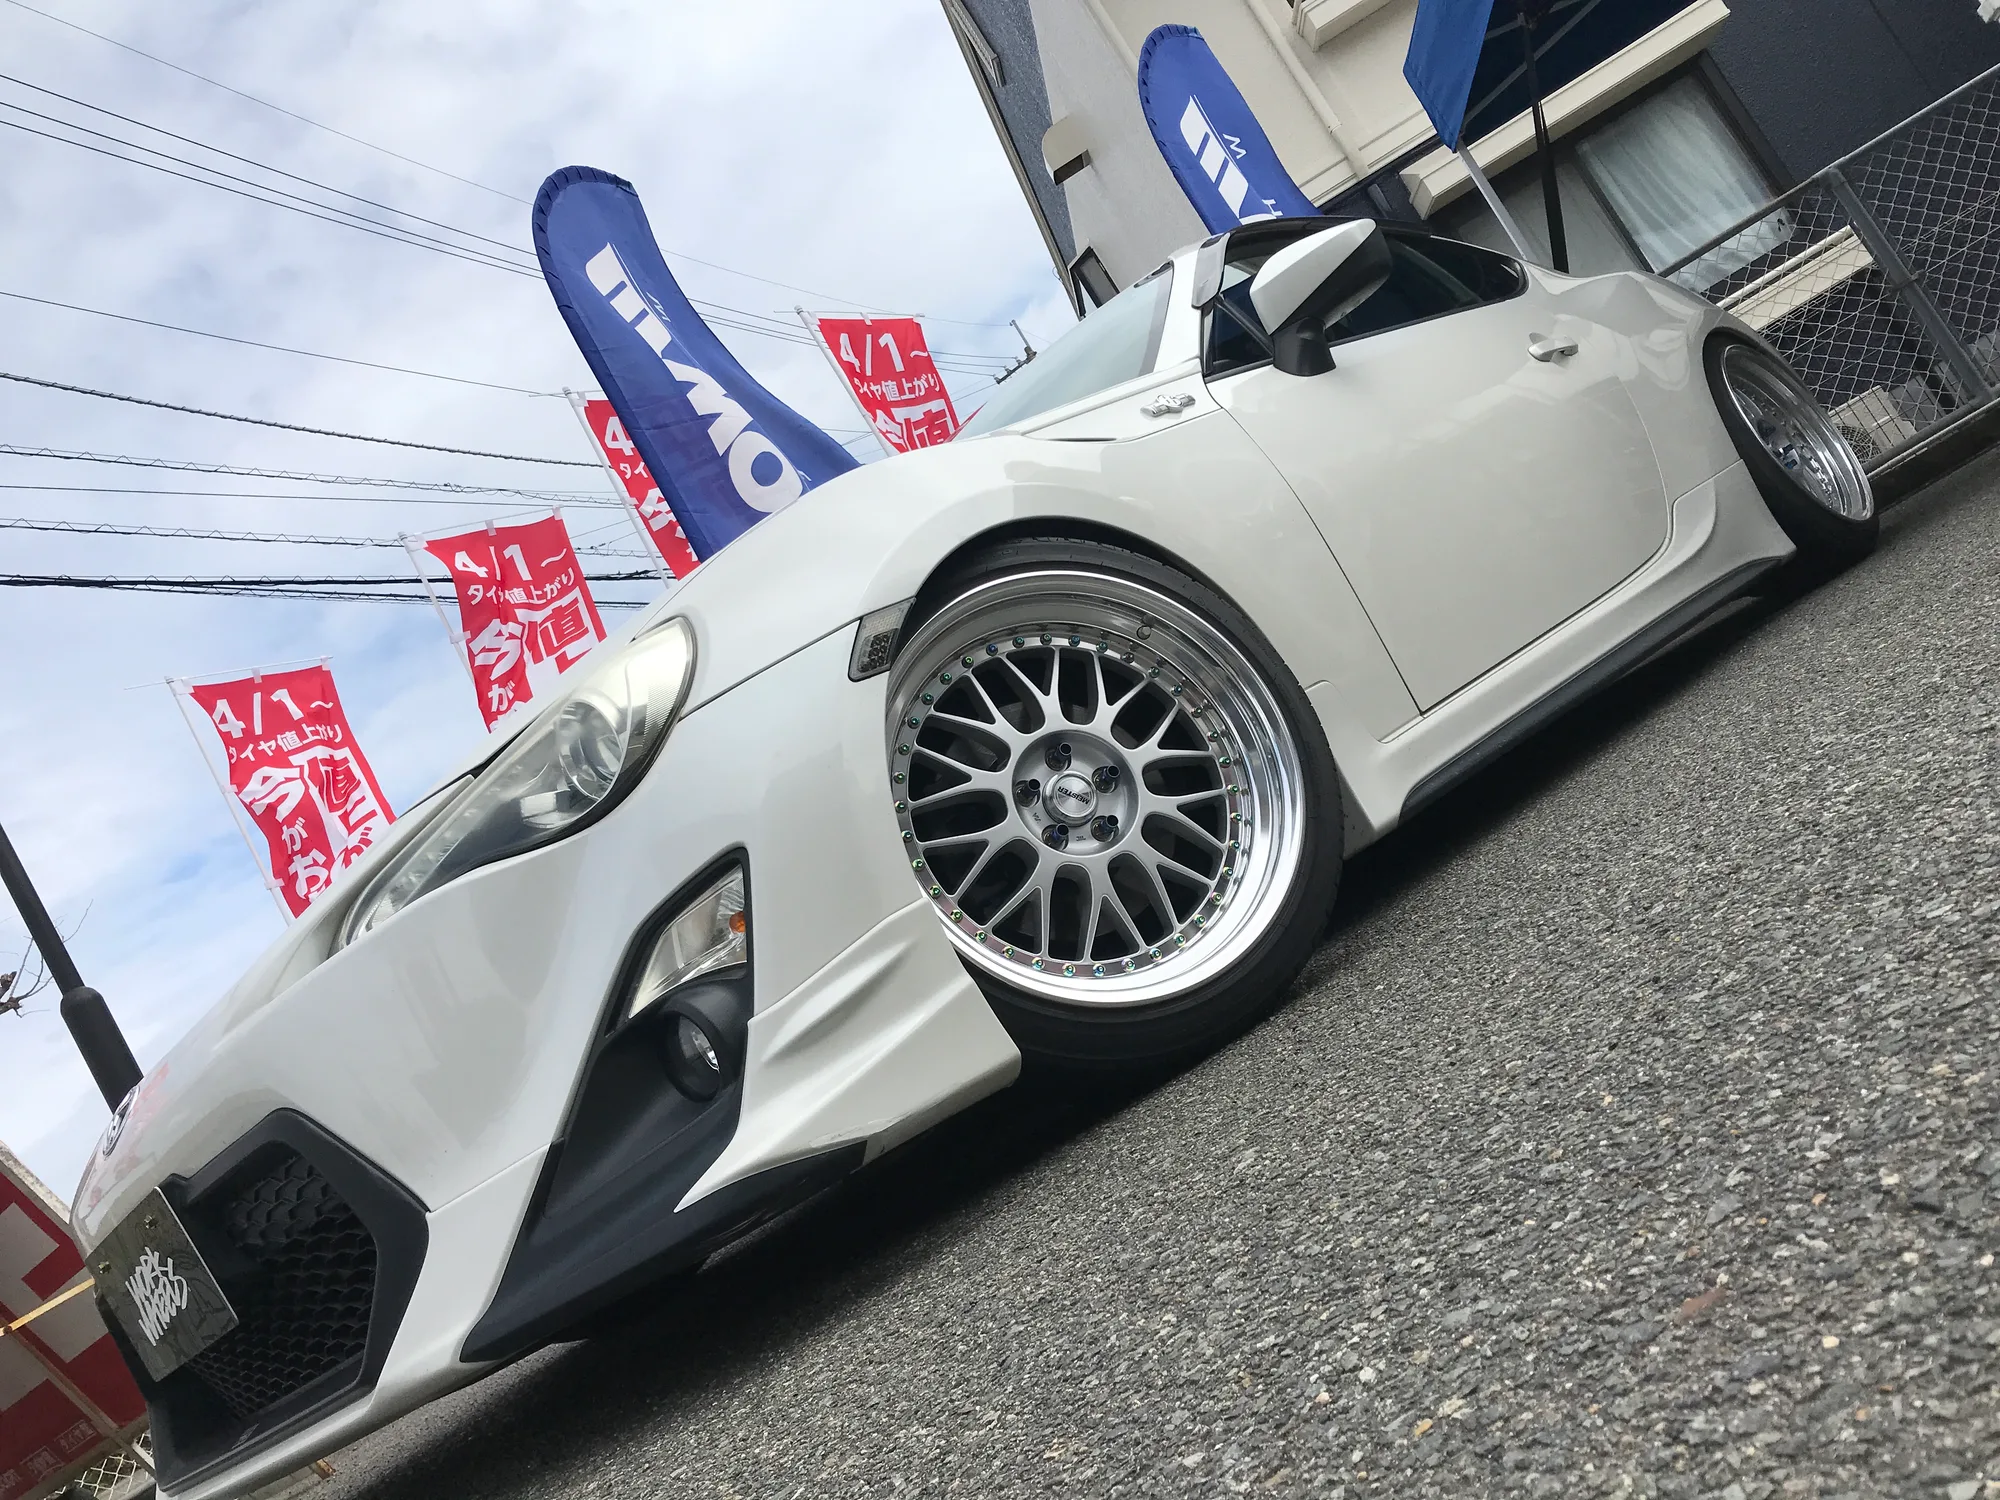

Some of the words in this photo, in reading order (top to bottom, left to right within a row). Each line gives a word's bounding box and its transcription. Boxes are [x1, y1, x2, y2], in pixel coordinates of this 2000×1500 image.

[854, 374, 939, 401] タイヤ値上がり
[469, 618, 524, 729] 今が
[228, 723, 342, 764] タイヤ値上がり
[1057, 786, 1090, 805] MEISTER
